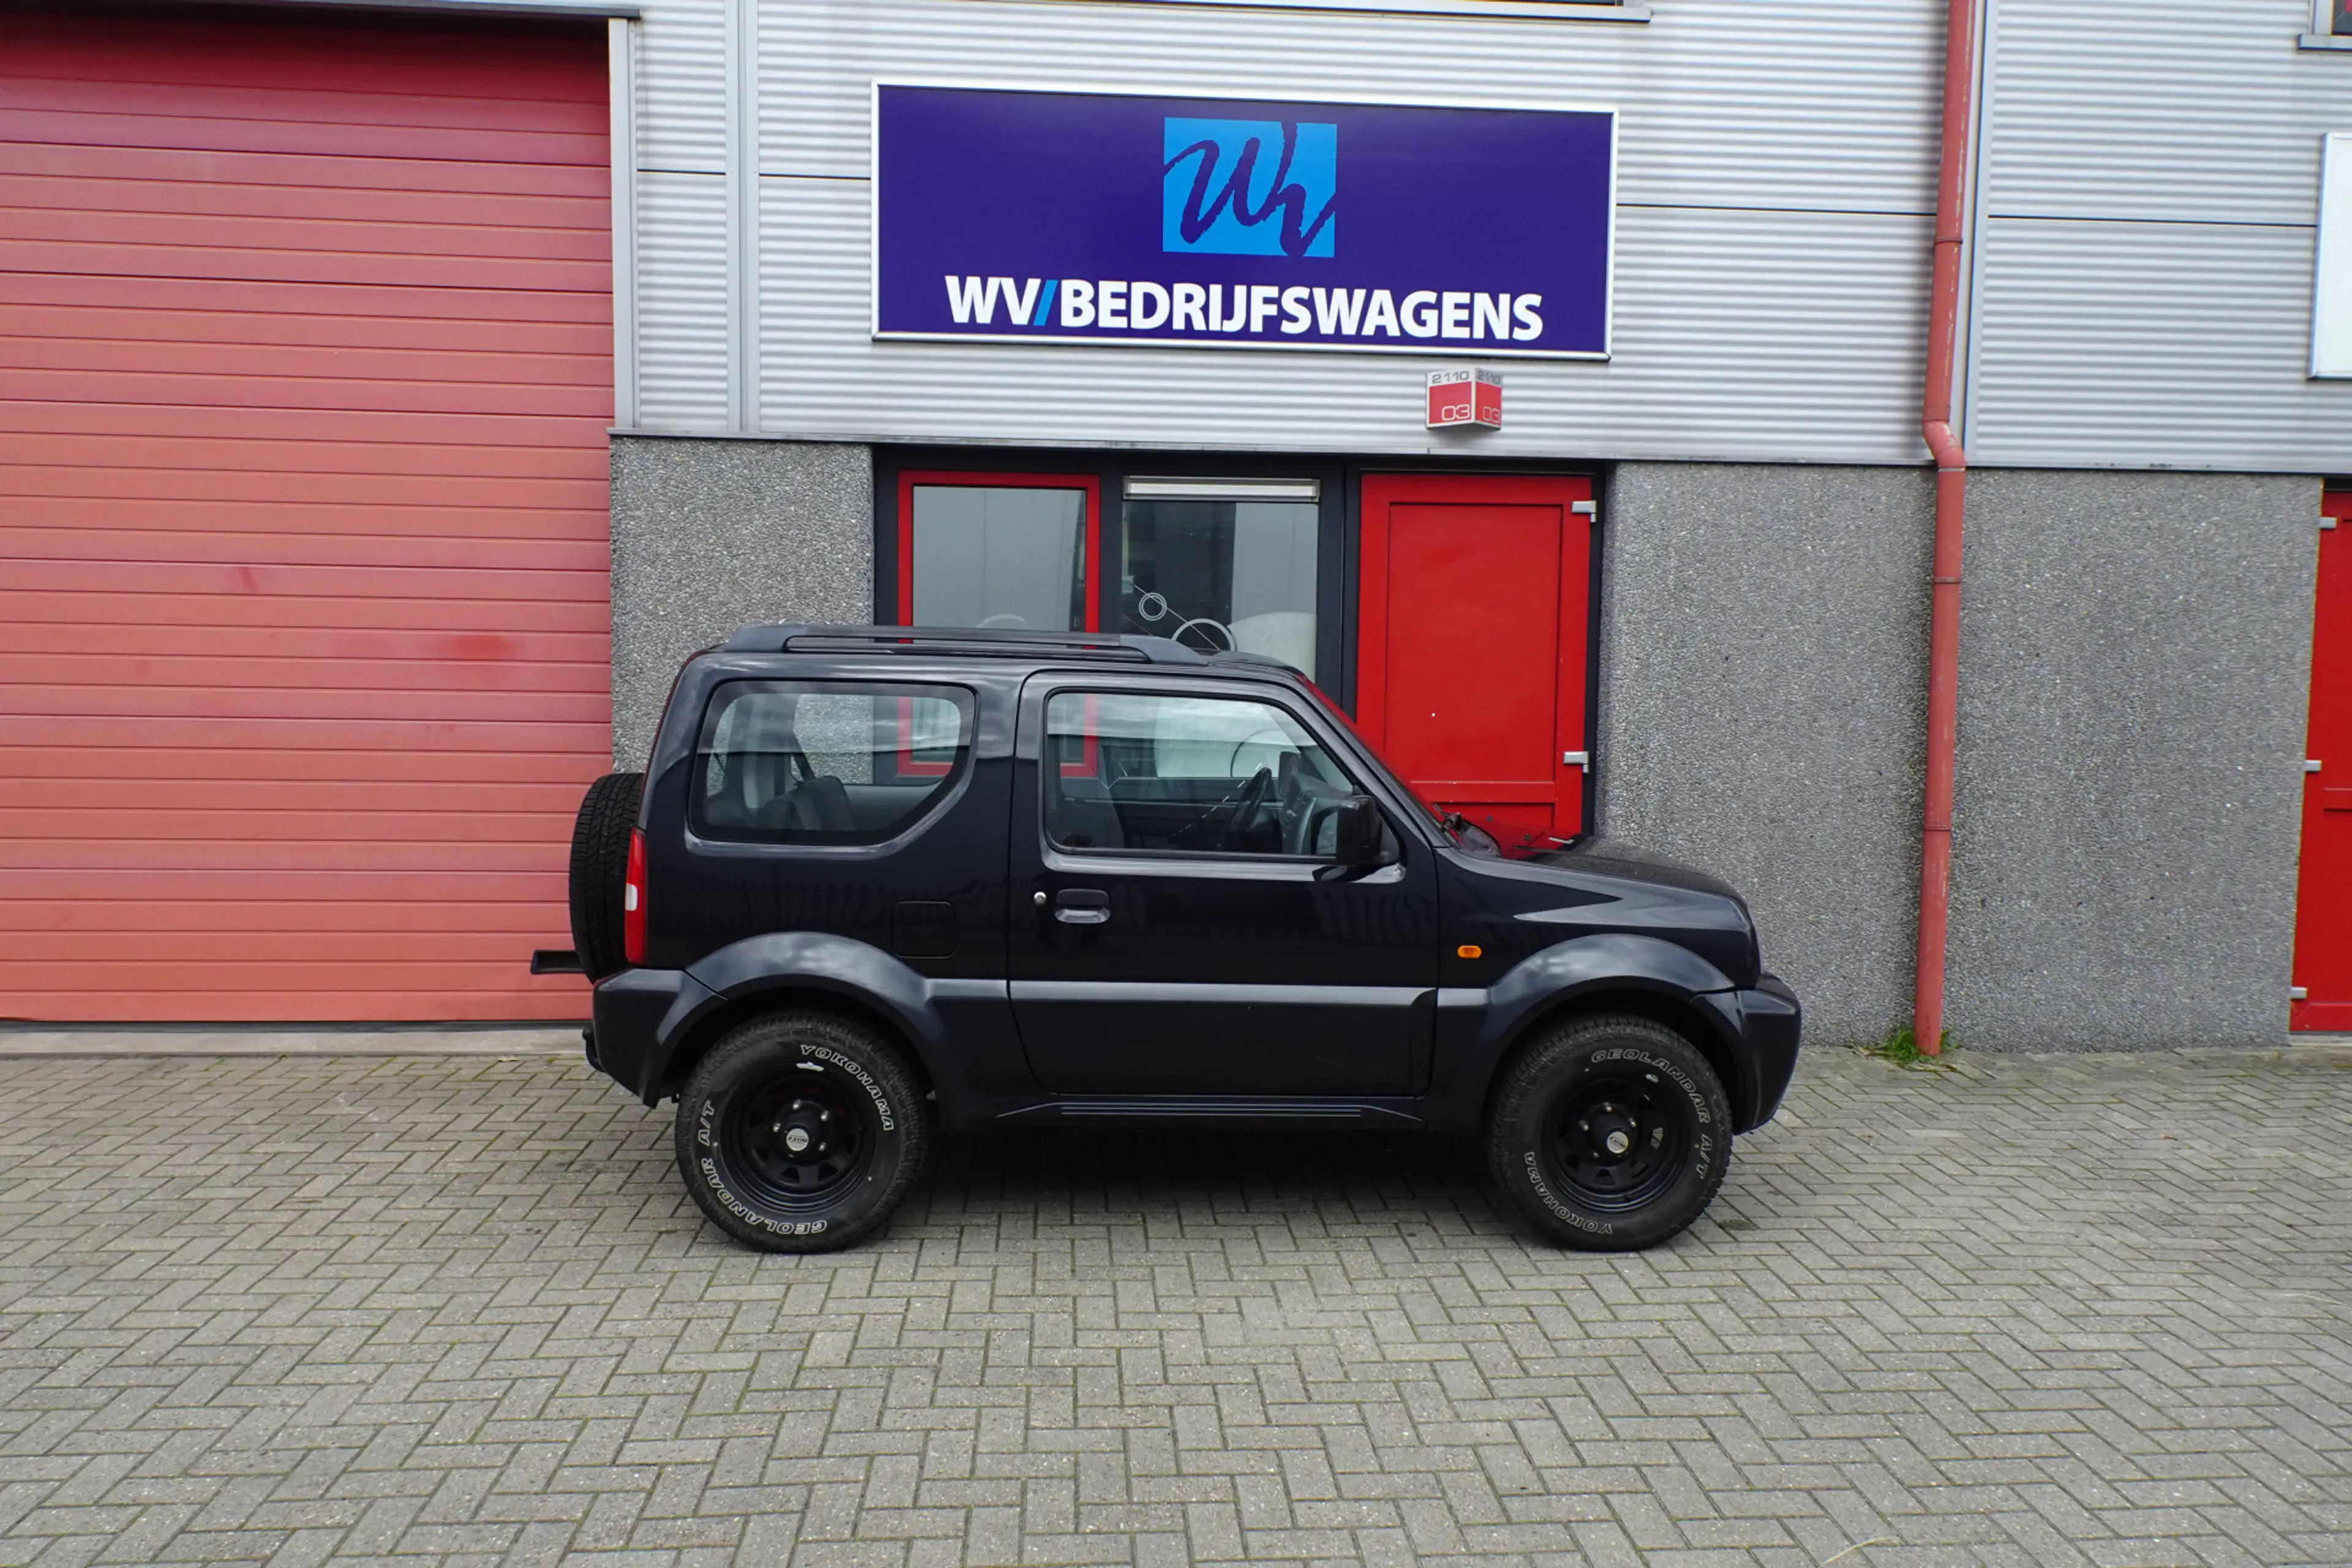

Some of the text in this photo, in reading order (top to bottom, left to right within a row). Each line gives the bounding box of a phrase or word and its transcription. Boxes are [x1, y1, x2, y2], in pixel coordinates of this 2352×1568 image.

[1432, 371, 1469, 384] 2110
[1476, 371, 1501, 385] 2110
[1442, 404, 1470, 421] 03
[1483, 406, 1500, 423] 03
[800, 1044, 894, 1131] YOKOHAMA
[1591, 1049, 1713, 1179] GEOLANDAR A/T
[698, 1100, 827, 1234] GEOLANDAR A/T
[1524, 1152, 1613, 1234] YOKOHAMA
